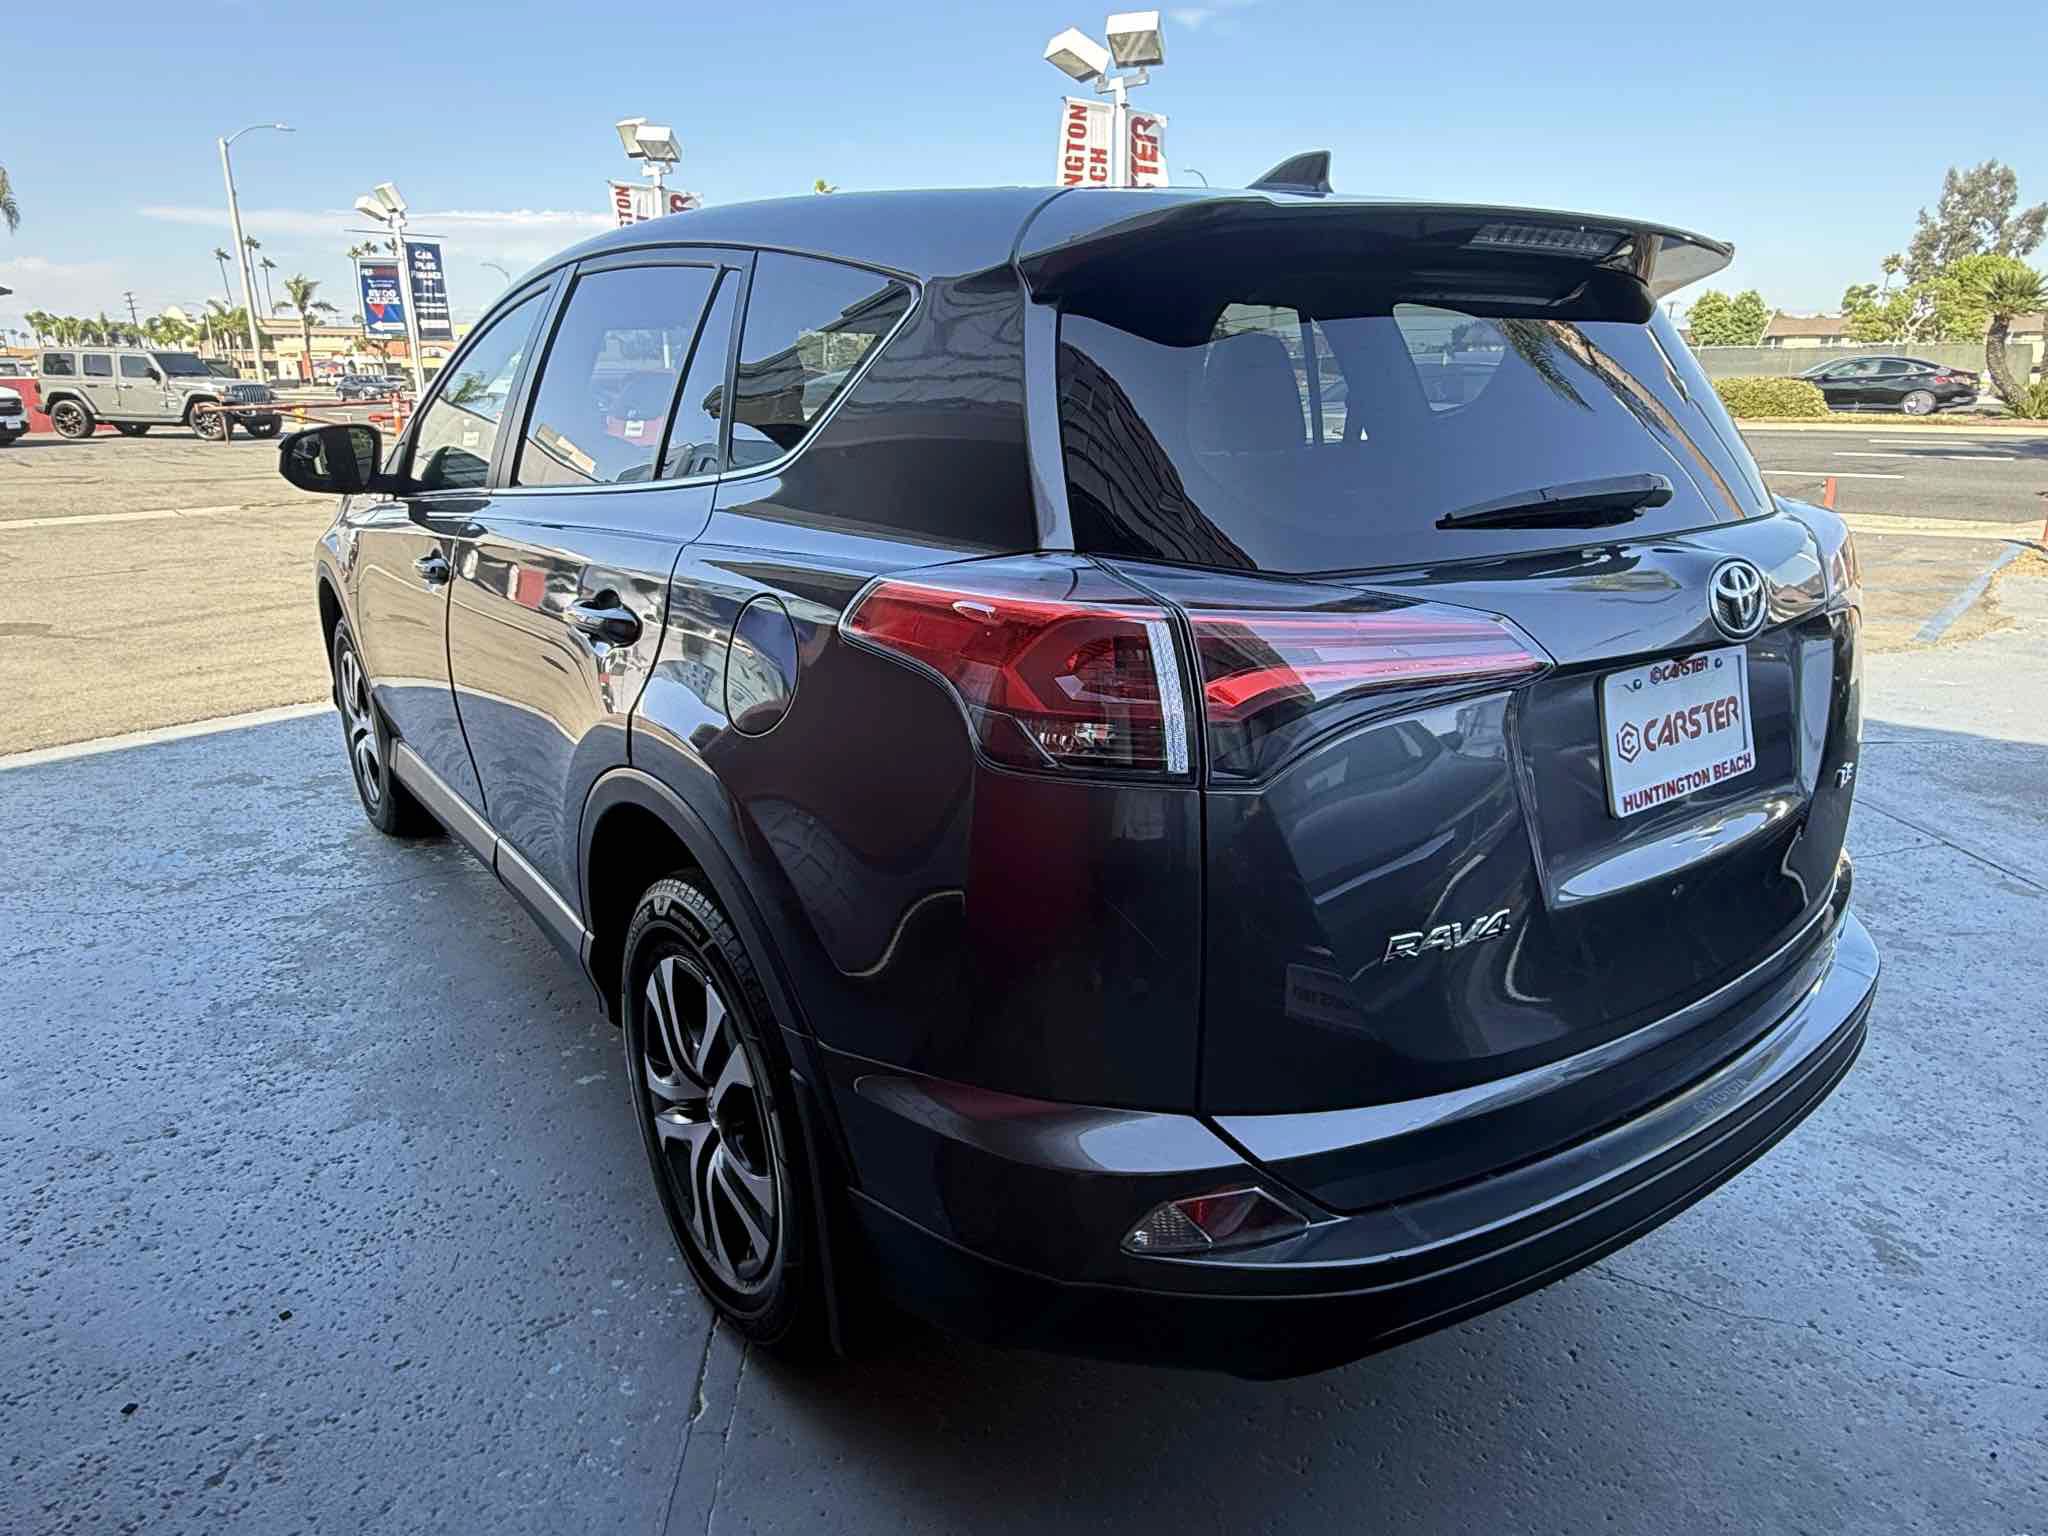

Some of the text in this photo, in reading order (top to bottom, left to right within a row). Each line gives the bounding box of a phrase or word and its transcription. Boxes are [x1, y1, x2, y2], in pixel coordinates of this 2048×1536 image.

[1643, 695, 1740, 752] CARSTER
[1622, 752, 1753, 814] HUNTINGTON BEACH
[1383, 907, 1512, 963] RAV4
